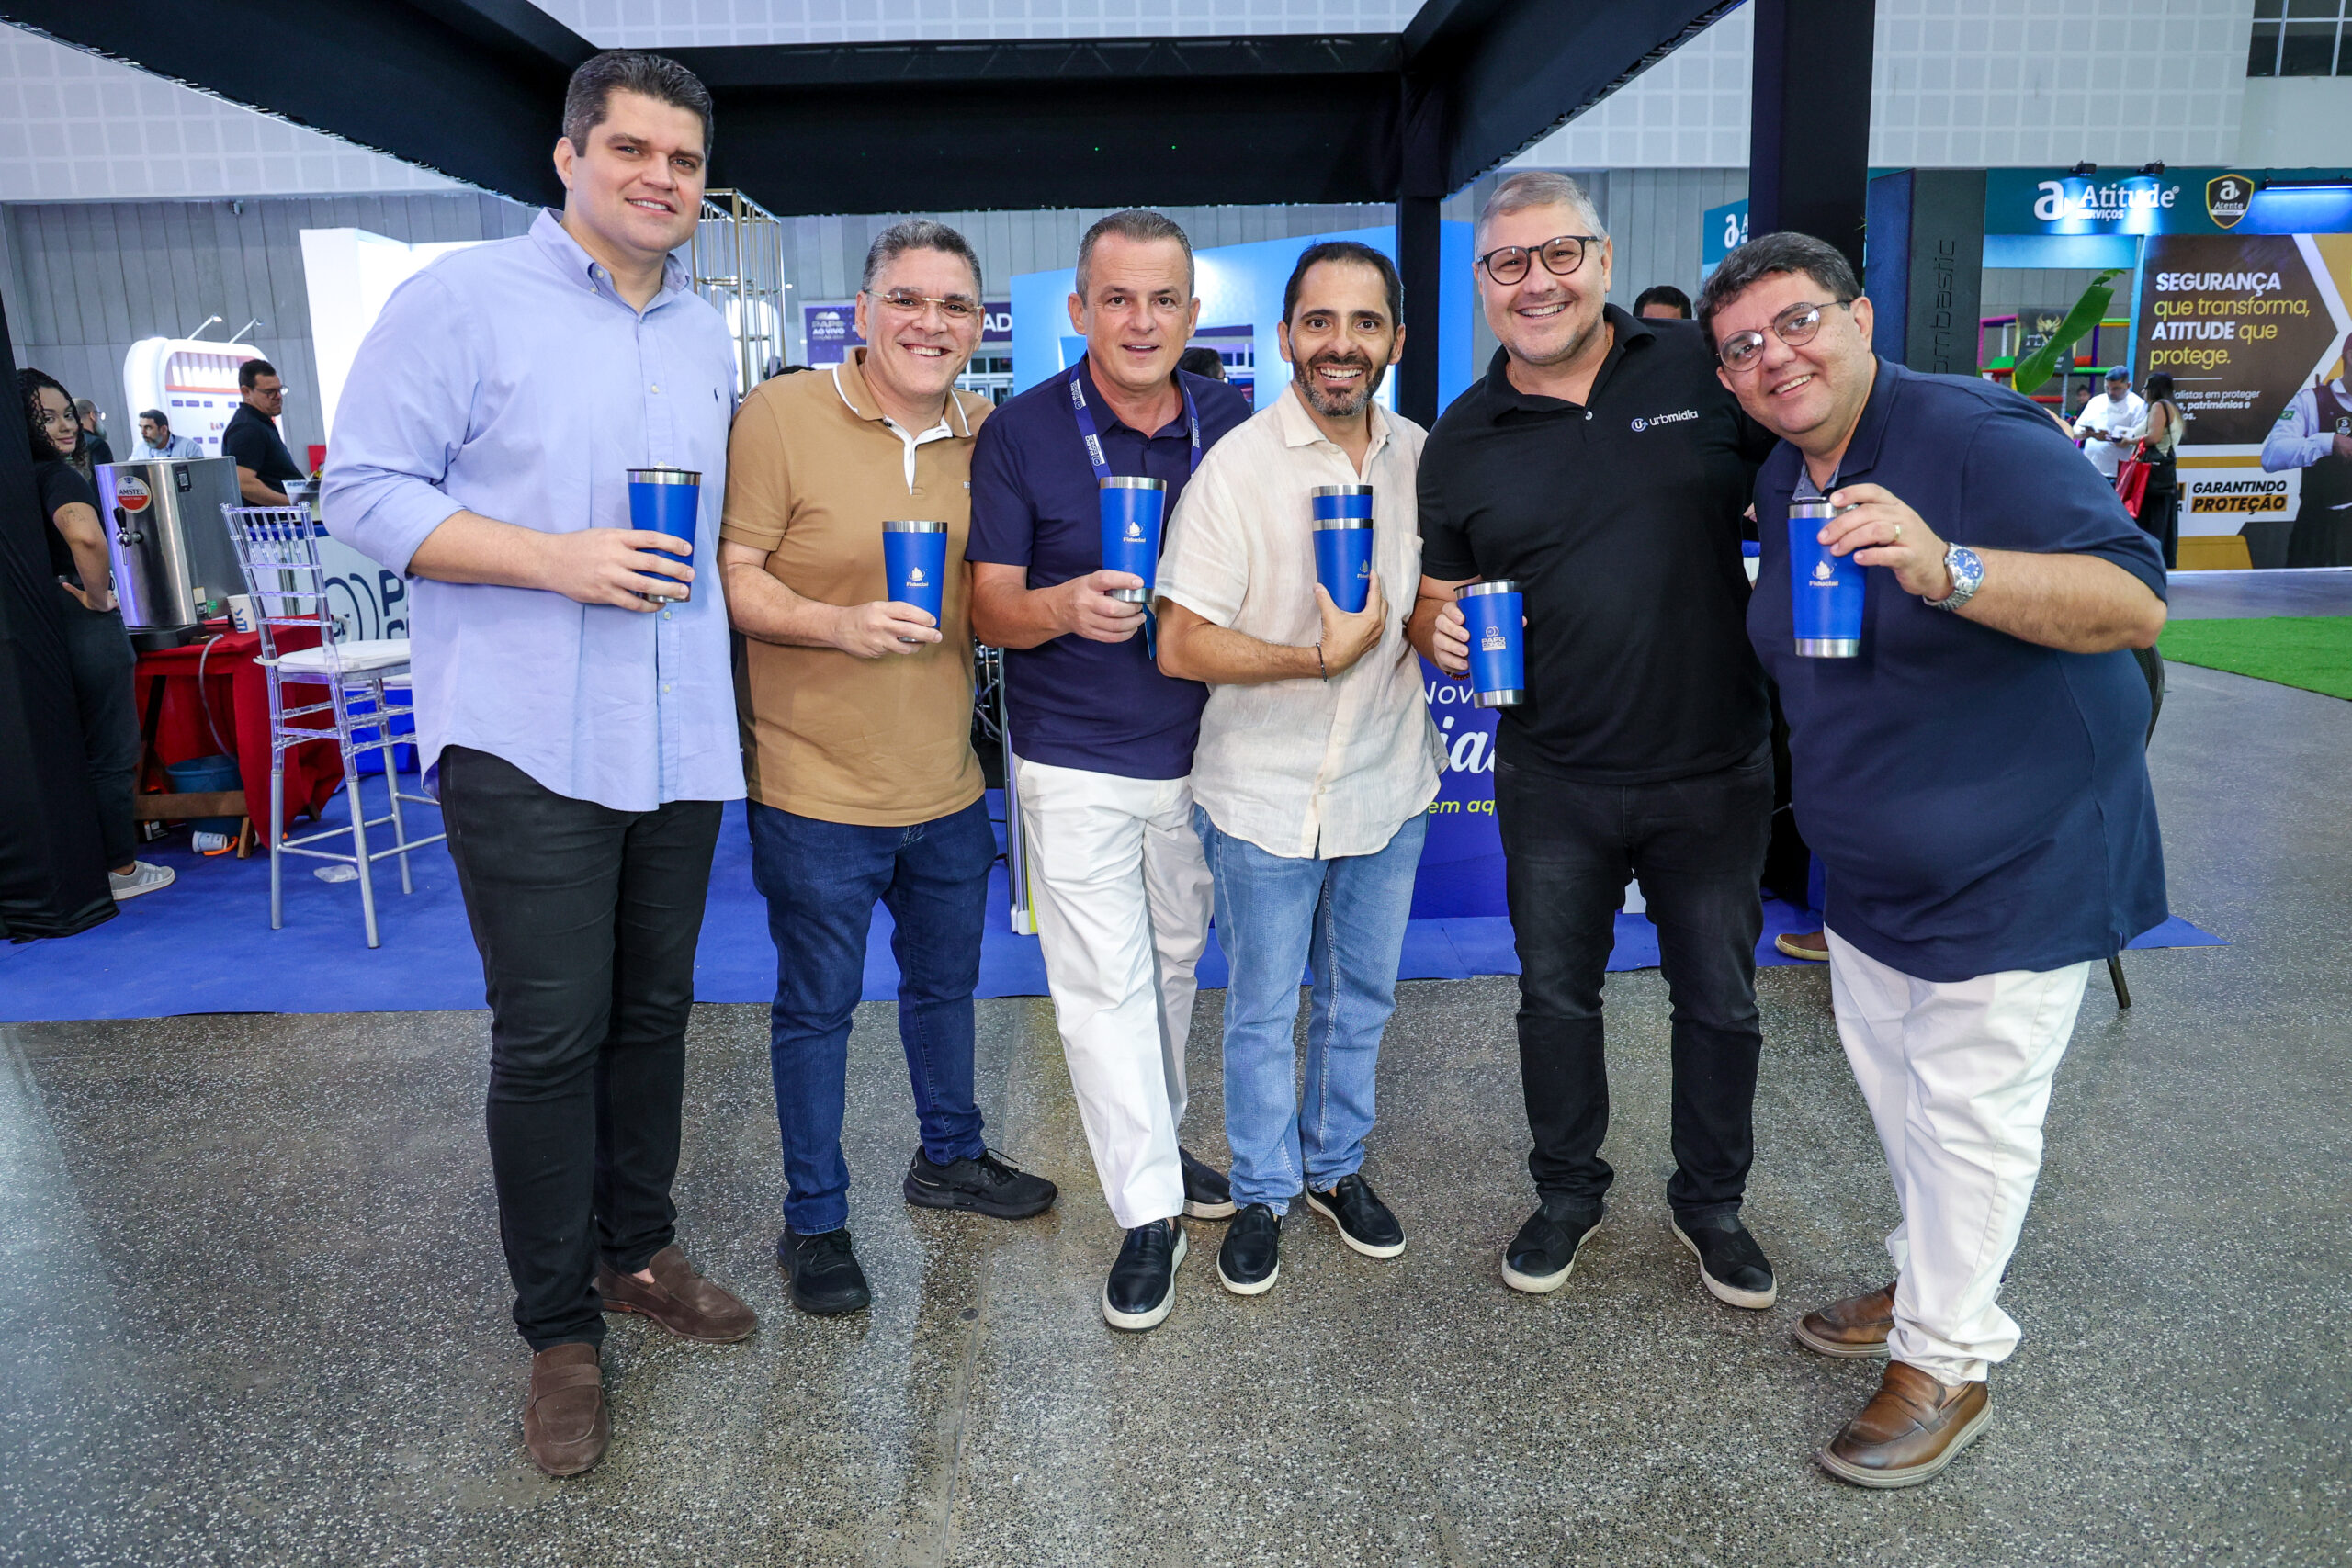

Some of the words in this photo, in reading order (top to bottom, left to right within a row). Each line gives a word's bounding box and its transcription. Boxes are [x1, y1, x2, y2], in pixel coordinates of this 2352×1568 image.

[2077, 183, 2176, 209] Atitude
[2214, 201, 2244, 209] Atente
[2075, 208, 2124, 221] ERVIÇOS
[2155, 272, 2282, 297] SEGURANÇA
[2154, 299, 2194, 321] que
[2198, 296, 2311, 318] transforma,
[2151, 321, 2235, 341] ATITUDE
[2239, 323, 2278, 345] que
[2149, 347, 2232, 371] protege.
[2173, 390, 2203, 399] alistas
[2205, 390, 2220, 399] em
[2222, 389, 2260, 401] proteger
[2192, 480, 2287, 494] GARANTINDO
[2192, 492, 2287, 515] PROTEÇÃO
